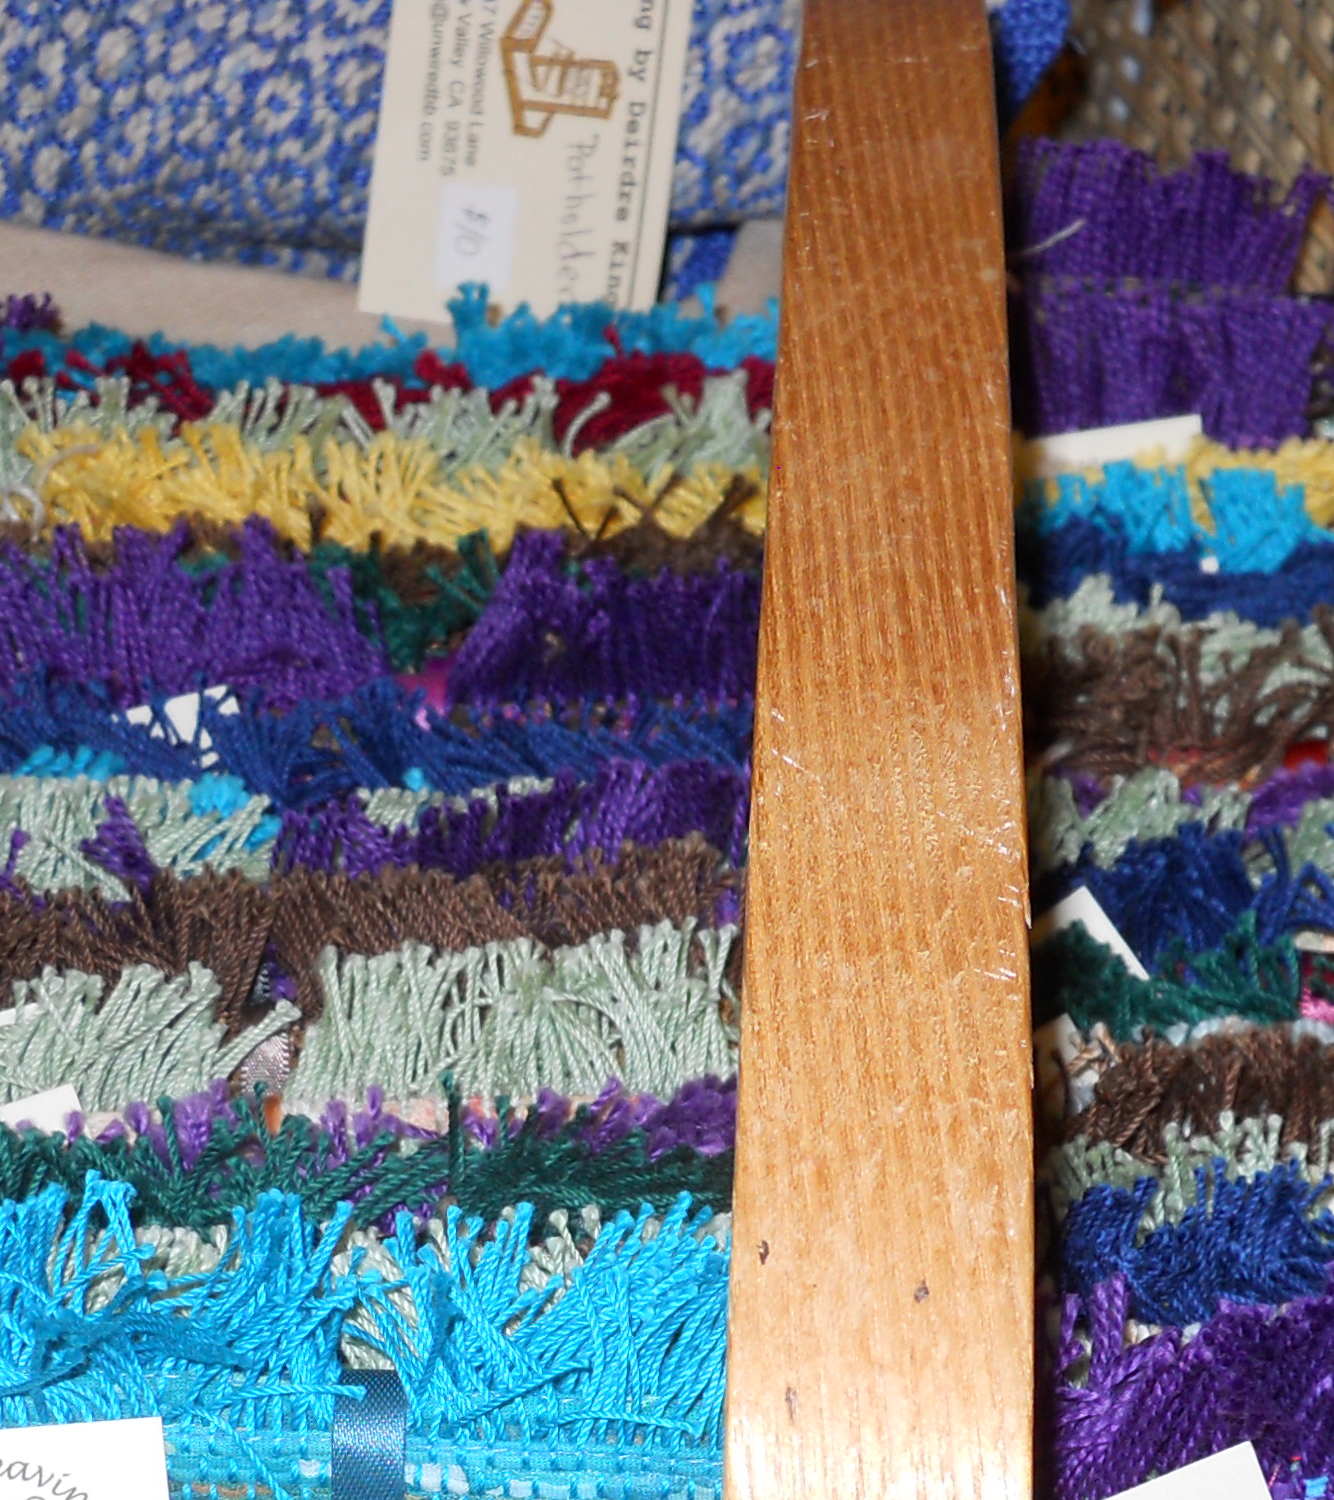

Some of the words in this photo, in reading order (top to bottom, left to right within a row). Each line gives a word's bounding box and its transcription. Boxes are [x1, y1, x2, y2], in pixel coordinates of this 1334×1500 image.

[450, 13, 472, 67] Valley
[627, 50, 651, 81] by
[446, 80, 466, 108] CA
[464, 122, 483, 167] Lane
[614, 102, 647, 222] Deirdre
